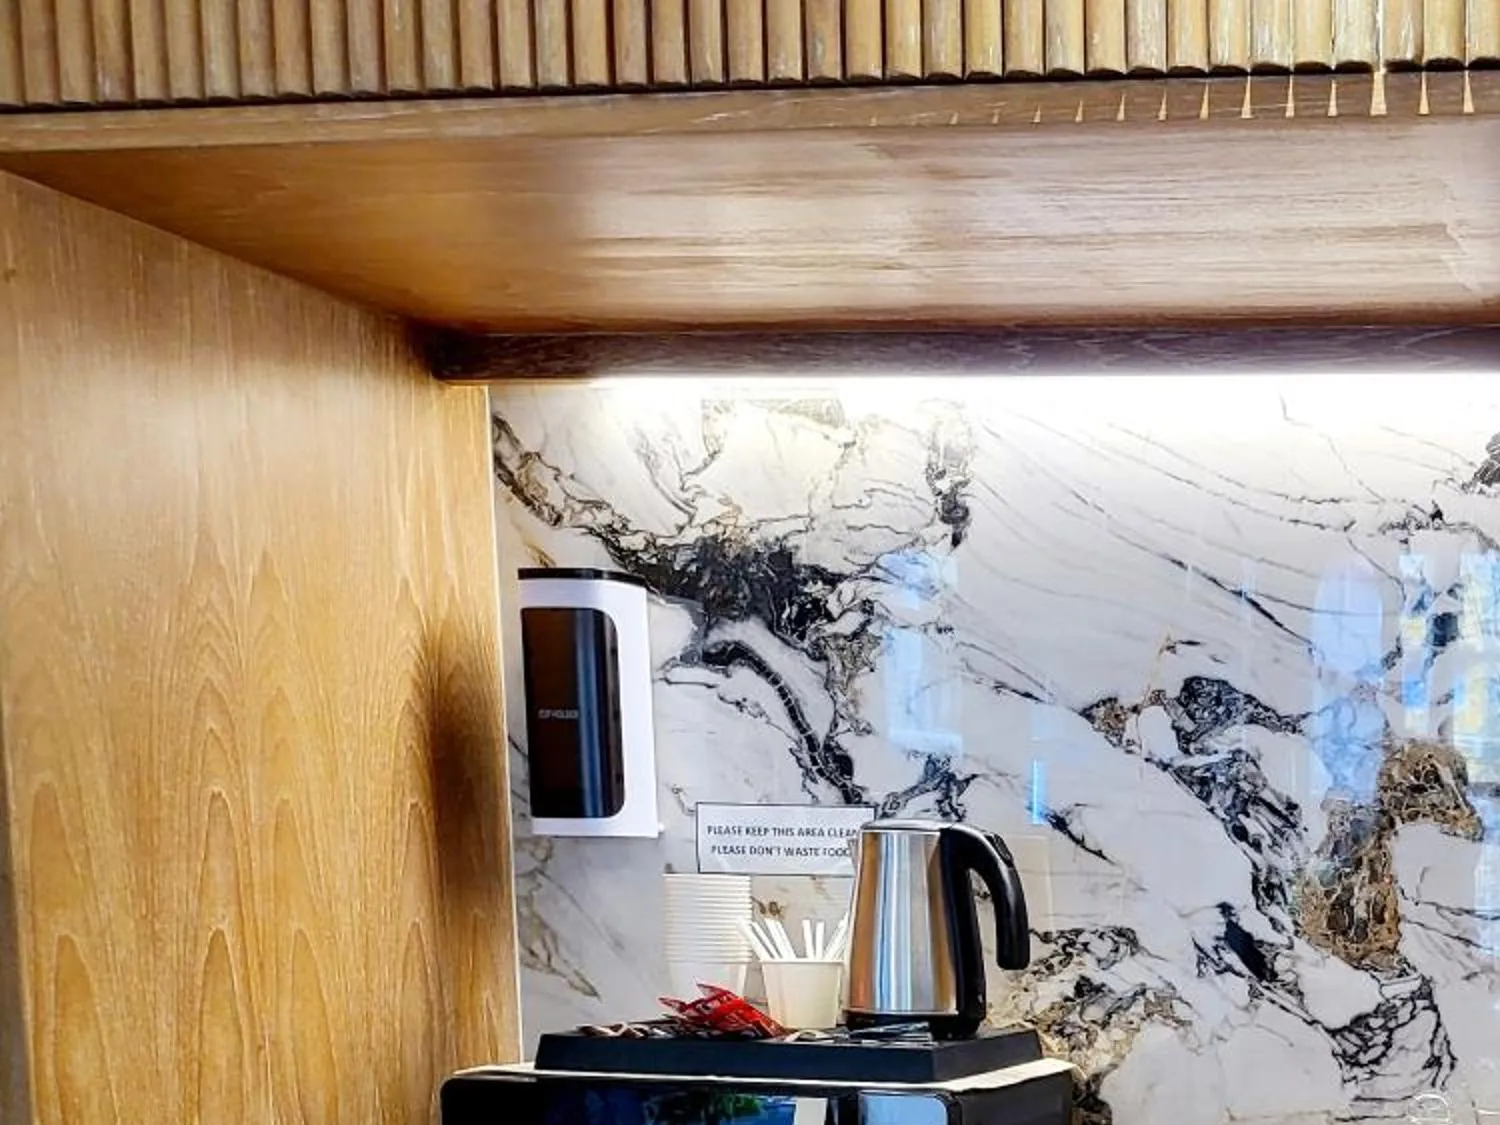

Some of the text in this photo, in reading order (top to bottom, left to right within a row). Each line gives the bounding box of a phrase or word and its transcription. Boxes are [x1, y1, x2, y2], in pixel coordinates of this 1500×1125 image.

[707, 825, 741, 835] PLEASE
[745, 826, 770, 837] KEEP
[772, 827, 795, 837] THIS
[797, 827, 825, 837] AREA
[711, 845, 746, 855] PLEASE
[750, 846, 781, 856] DON'T
[783, 847, 819, 857] WASTE
